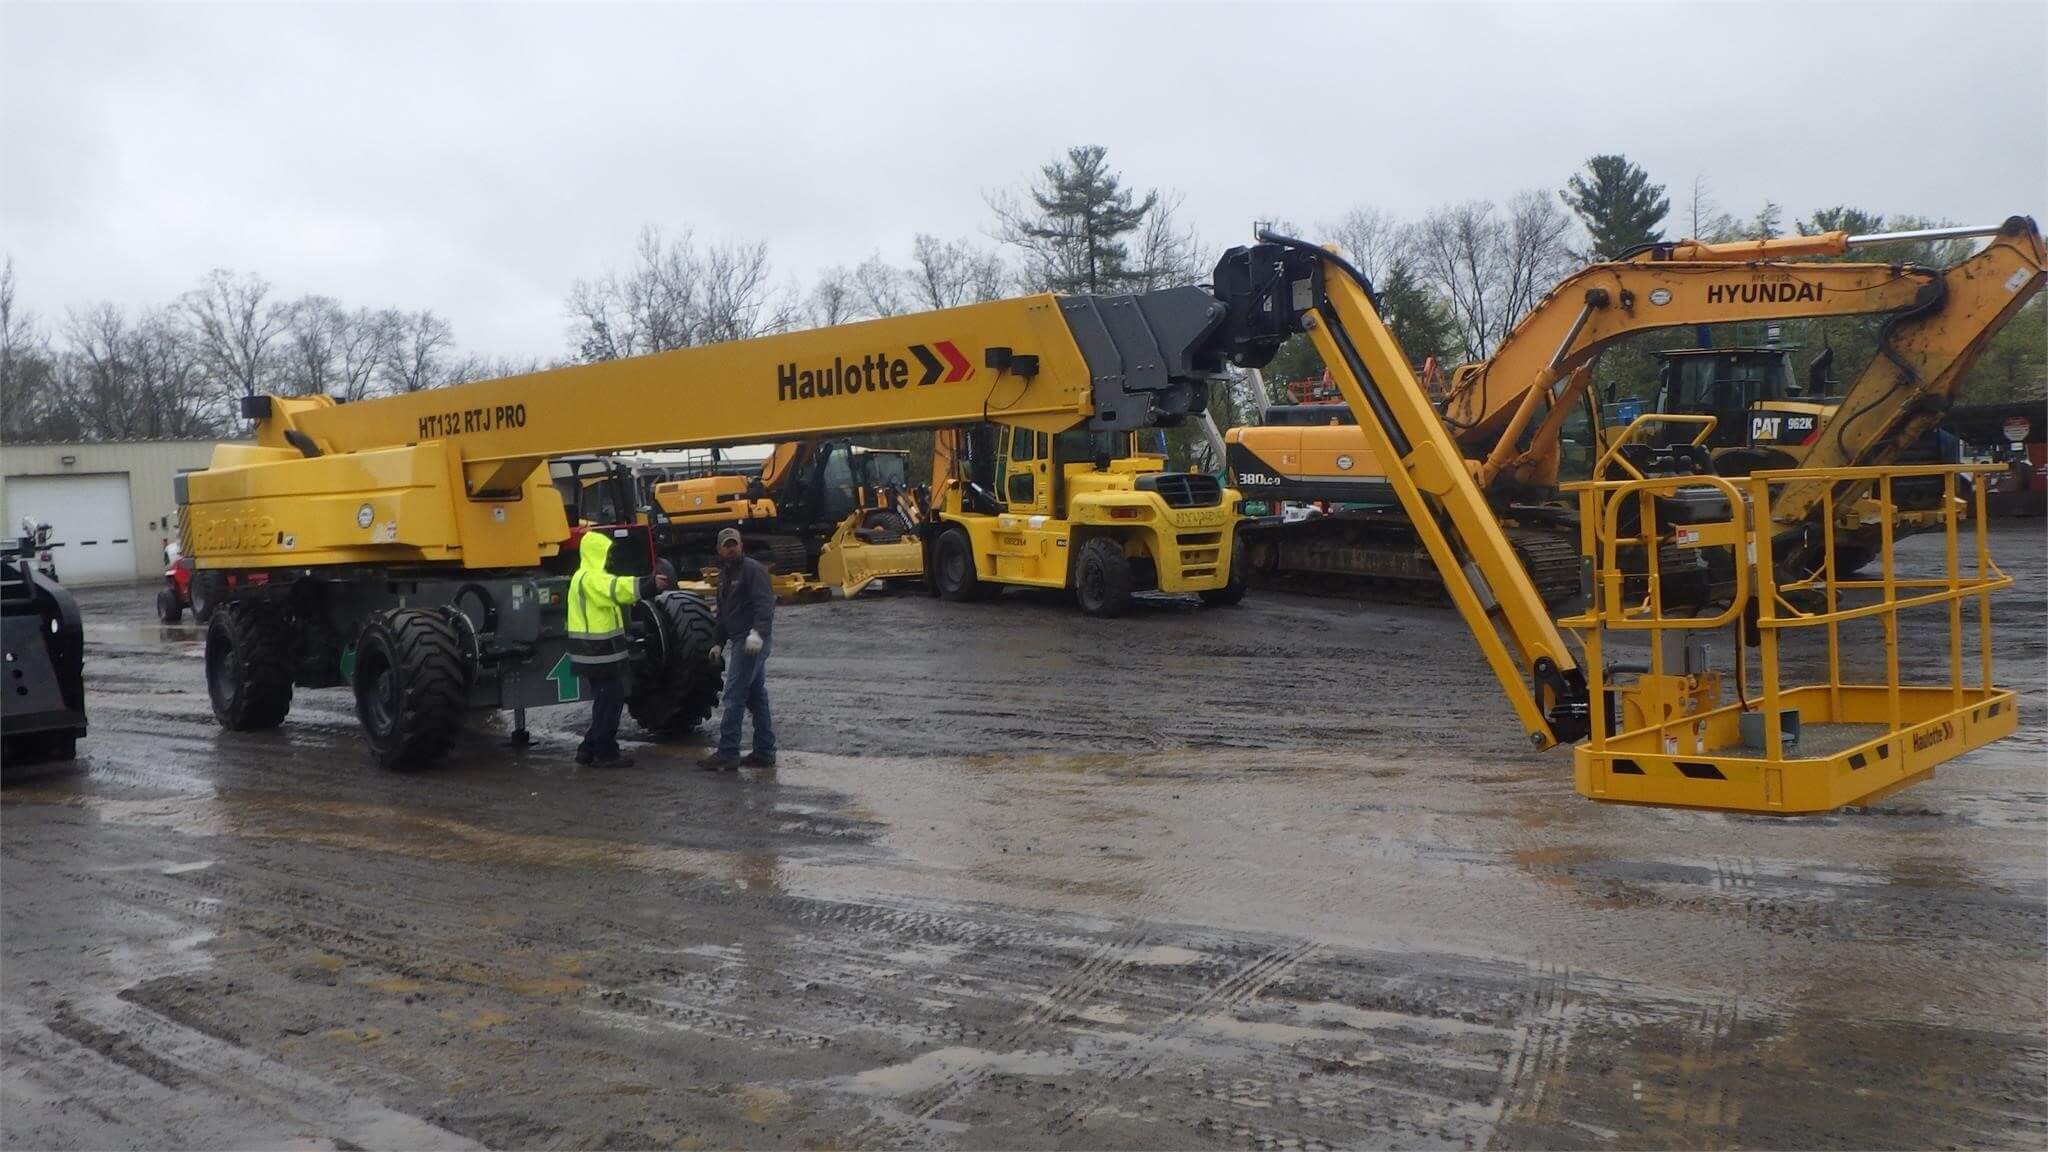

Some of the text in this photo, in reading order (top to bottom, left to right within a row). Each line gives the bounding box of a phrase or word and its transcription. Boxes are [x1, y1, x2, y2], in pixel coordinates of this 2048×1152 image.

[1707, 282, 1823, 304] HYUNDAI
[778, 353, 909, 400] Haulotte
[419, 403, 526, 439] HT132 RTJ PRO
[1752, 417, 1782, 440] CAT
[1788, 417, 1813, 430] 962K
